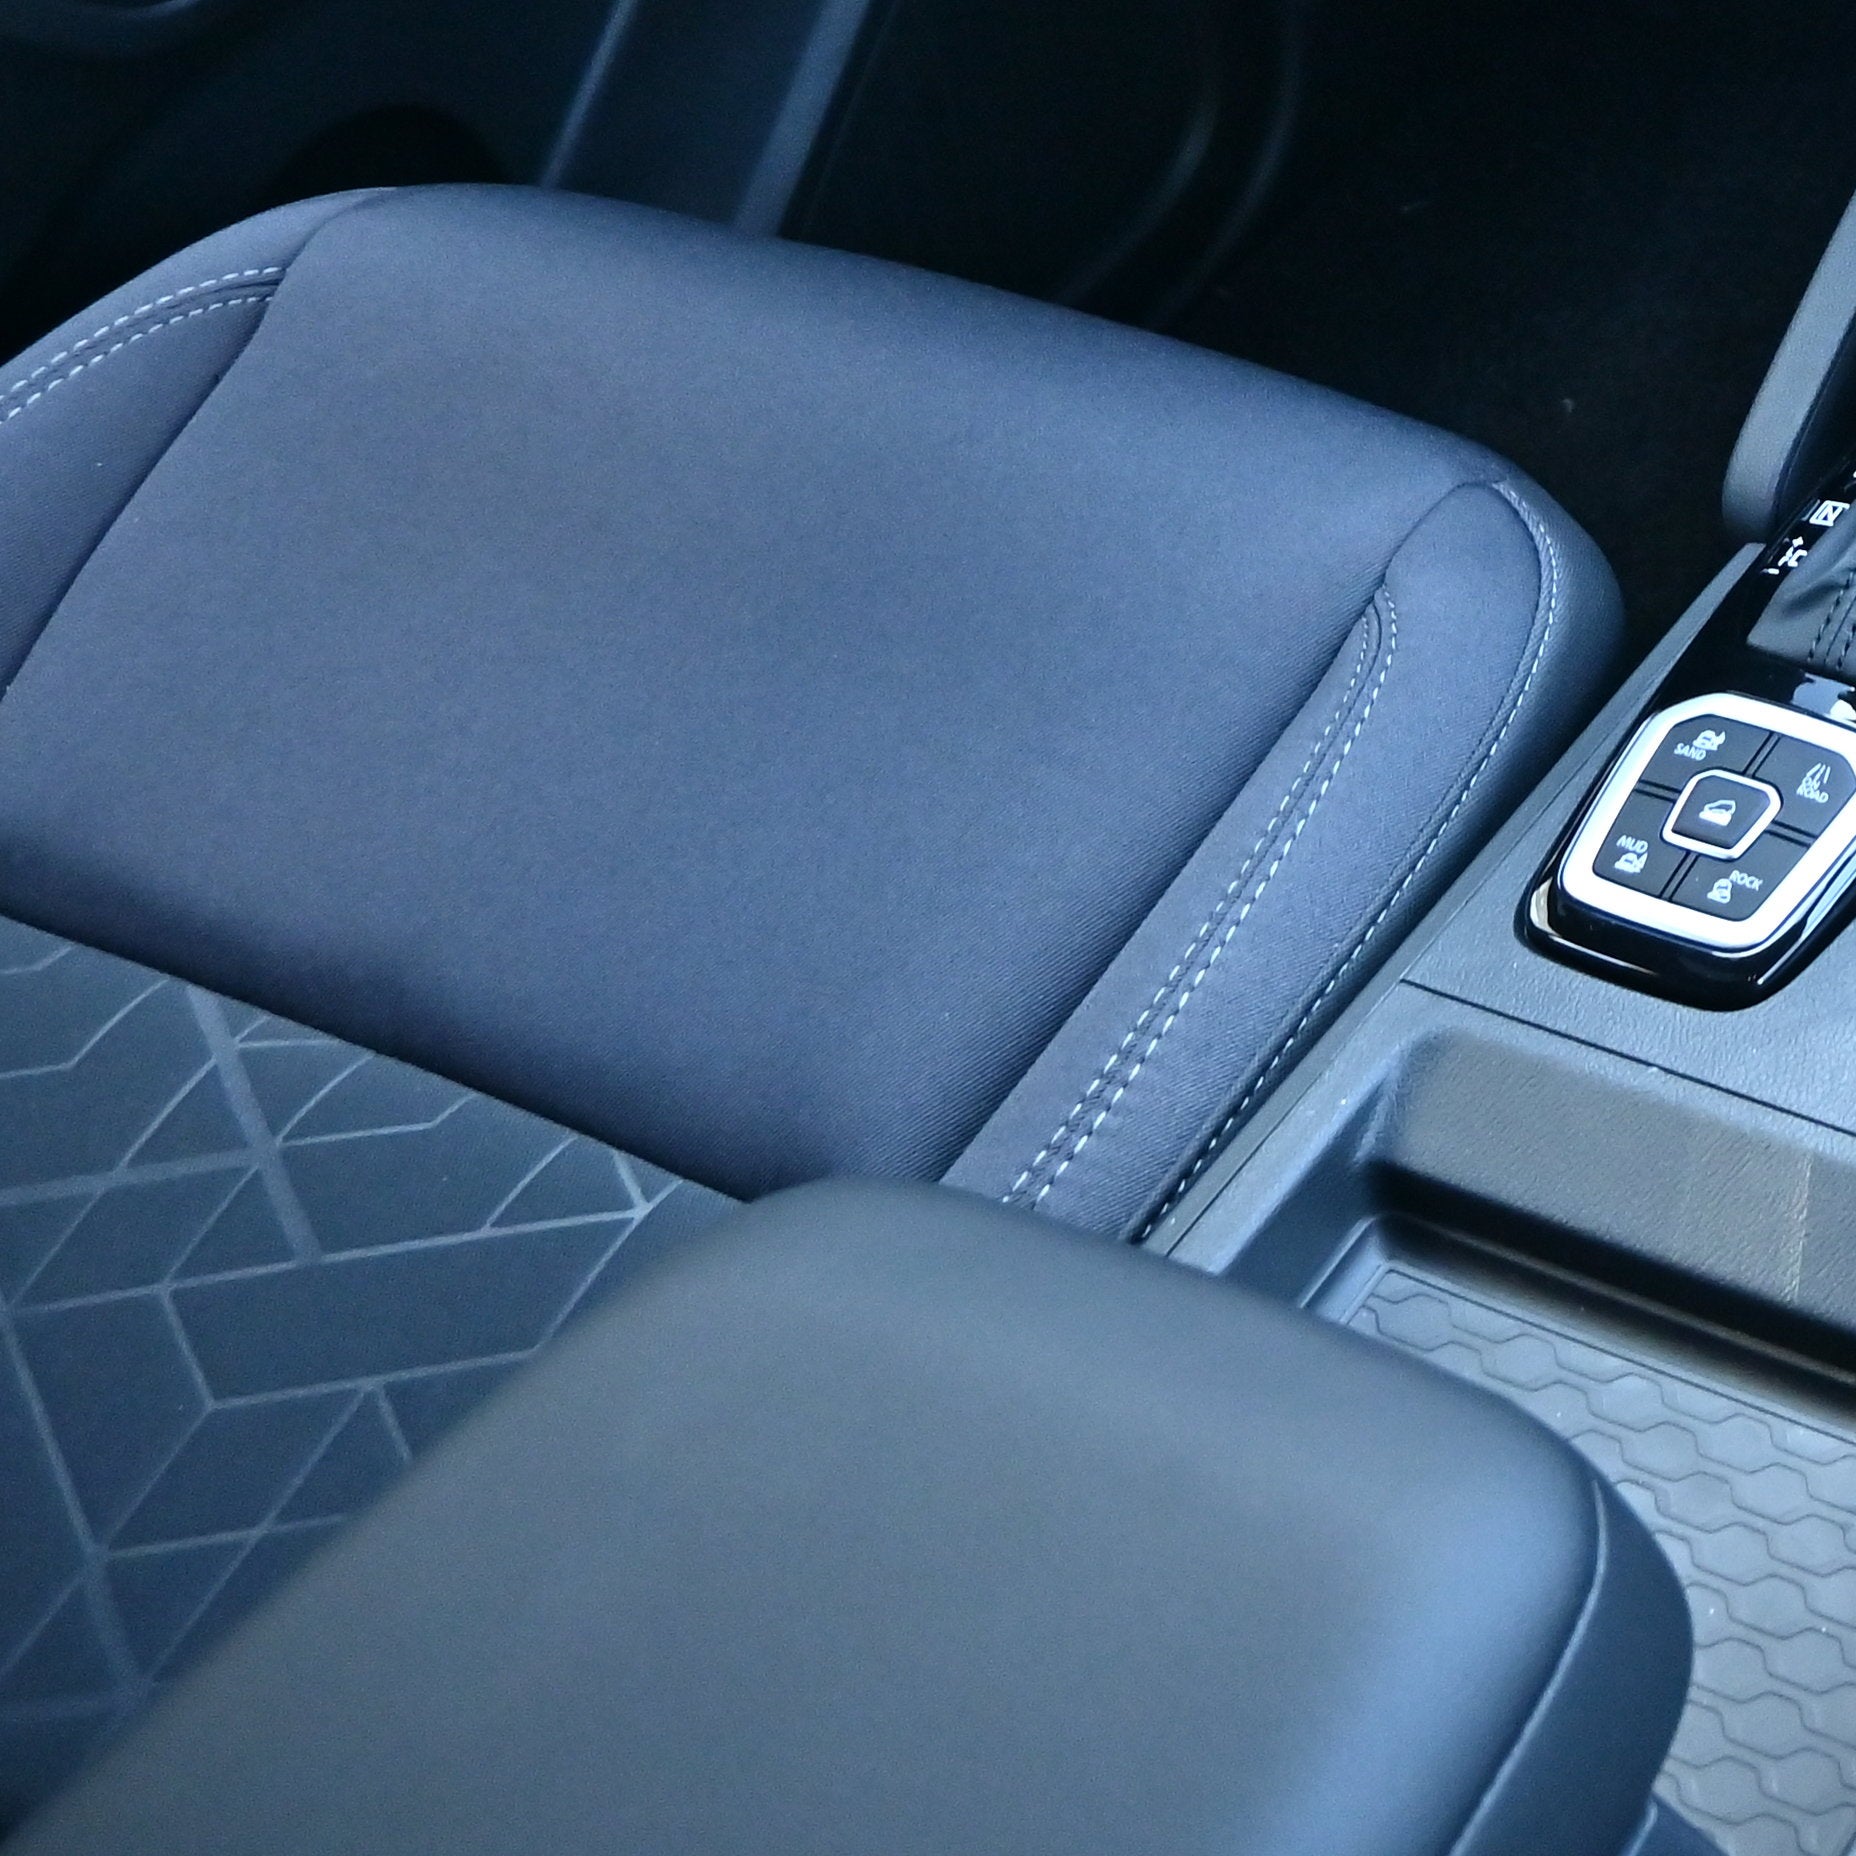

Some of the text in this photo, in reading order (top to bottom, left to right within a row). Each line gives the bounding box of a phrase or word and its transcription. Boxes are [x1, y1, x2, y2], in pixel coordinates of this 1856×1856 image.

[1674, 742, 1707, 762] SAND
[1796, 782, 1830, 804] ROAD
[1616, 834, 1649, 853] MUD
[1729, 869, 1764, 892] ROCK
